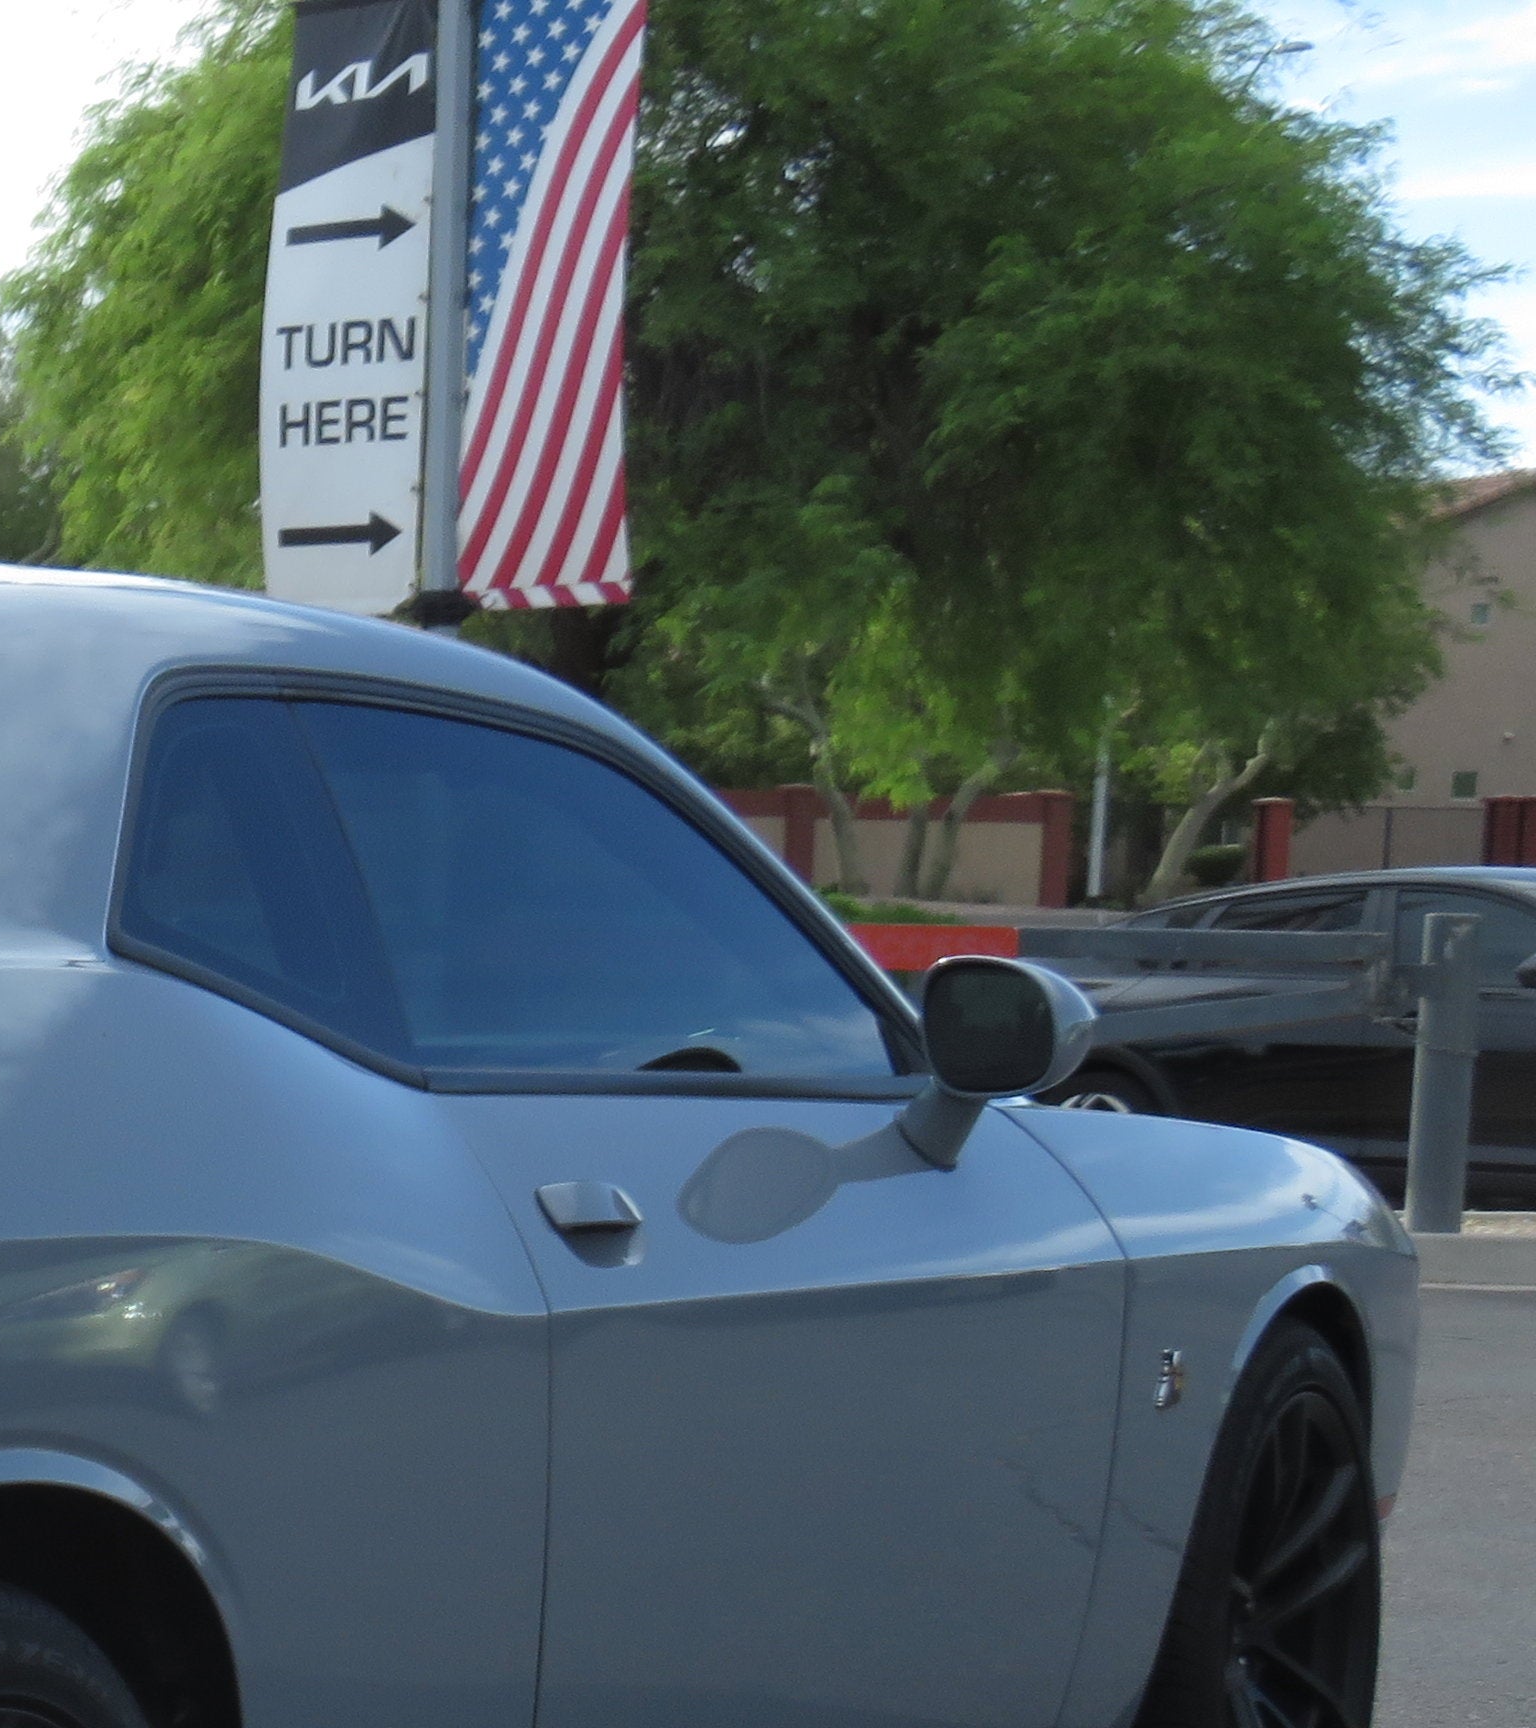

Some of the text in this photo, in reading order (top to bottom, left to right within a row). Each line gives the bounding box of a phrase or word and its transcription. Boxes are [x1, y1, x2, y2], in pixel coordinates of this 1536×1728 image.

[295, 53, 428, 111] KIA
[276, 317, 416, 370] TURN
[279, 397, 409, 448] HERE
